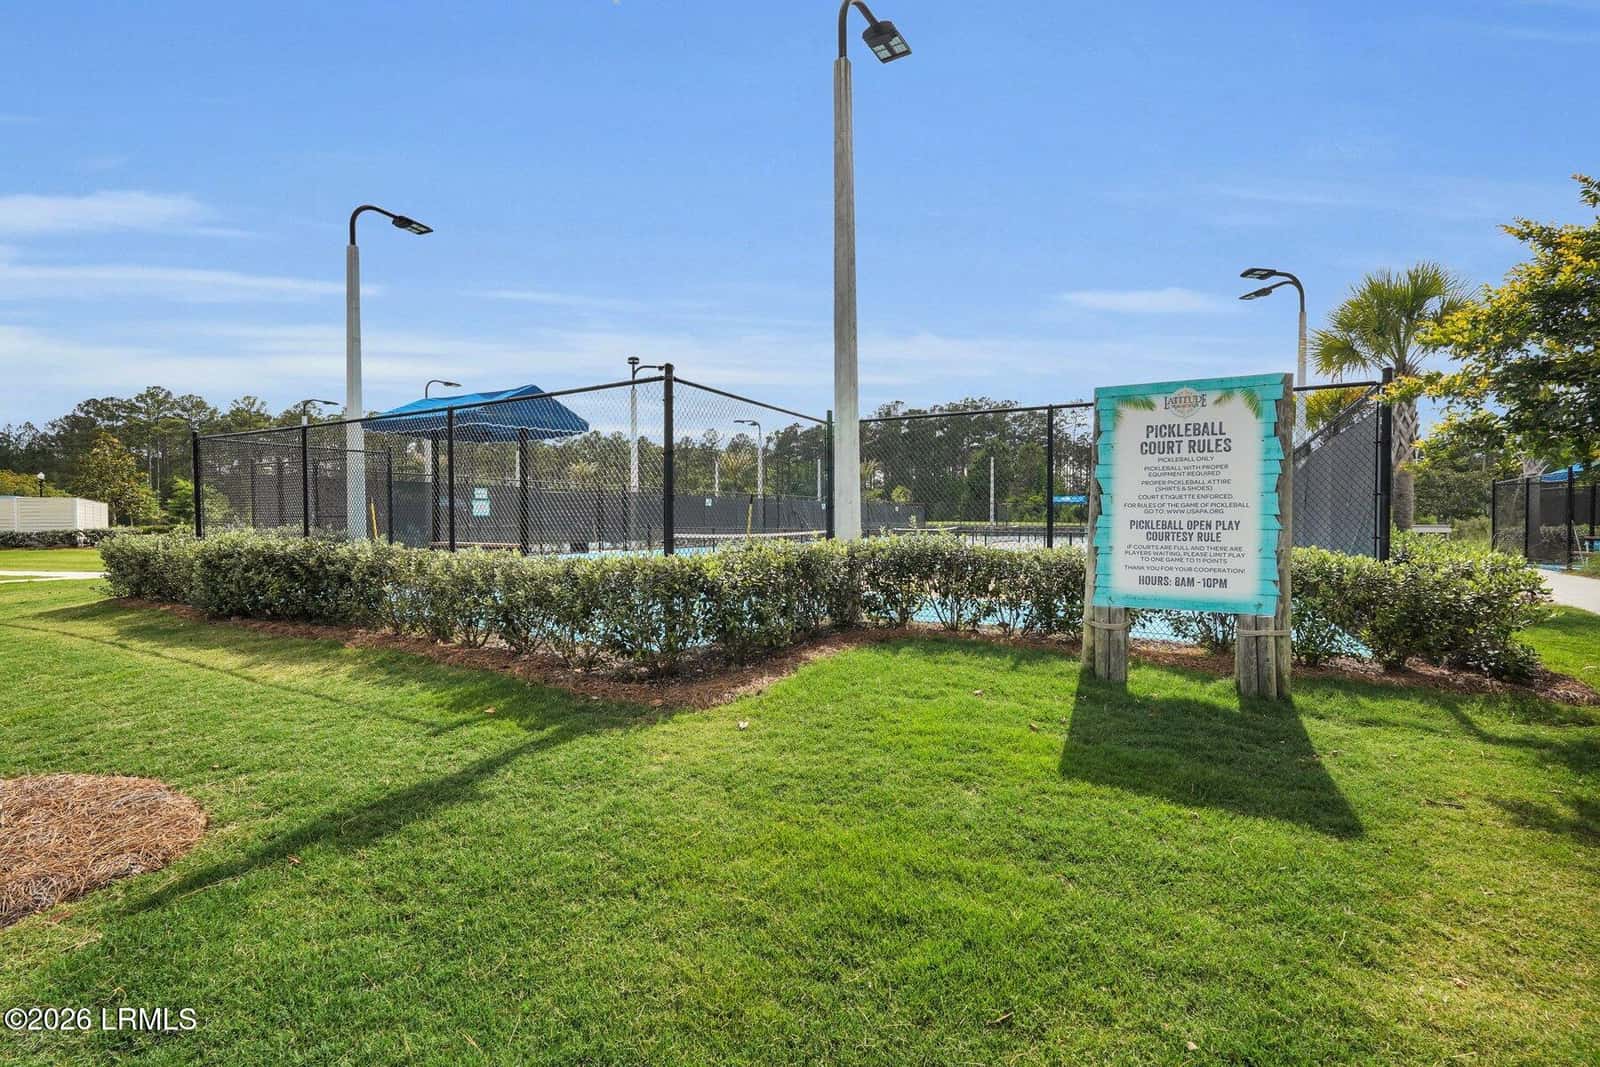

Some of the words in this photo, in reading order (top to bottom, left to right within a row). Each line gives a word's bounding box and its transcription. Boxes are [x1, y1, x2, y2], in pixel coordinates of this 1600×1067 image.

[1146, 421, 1226, 439] PICKLEBALL
[1140, 440, 1183, 455] COURT
[1188, 438, 1232, 454] RULES
[1130, 520, 1183, 530] PICKLEBALL
[1186, 520, 1212, 530] OPEN
[1216, 520, 1241, 531] PLAY
[1146, 532, 1194, 542] COURTESY
[1197, 532, 1222, 542] RULE
[1138, 576, 1171, 586] HOURS:
